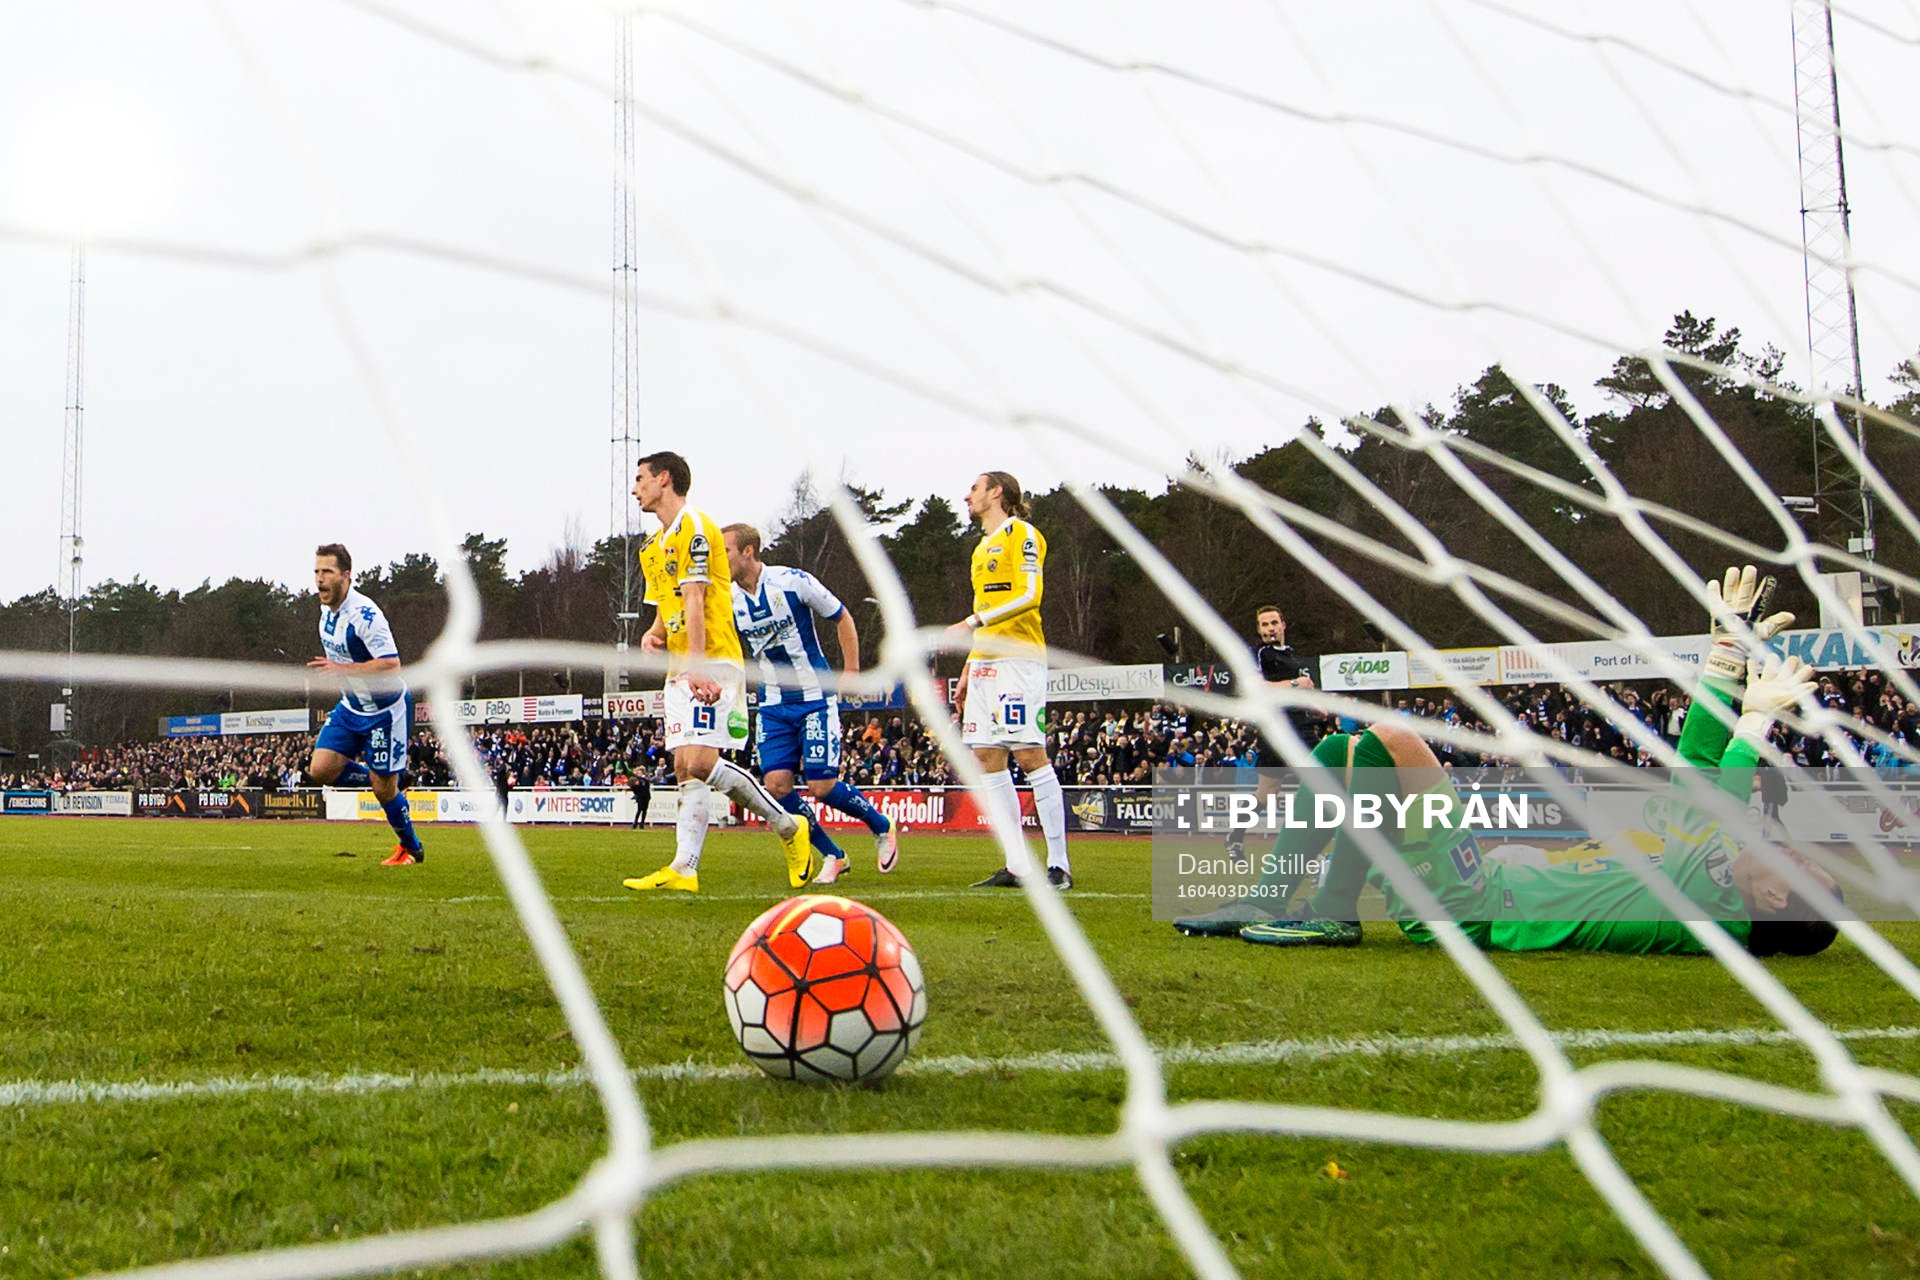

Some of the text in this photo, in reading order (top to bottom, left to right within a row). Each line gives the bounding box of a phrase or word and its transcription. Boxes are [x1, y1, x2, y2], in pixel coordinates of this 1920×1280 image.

[1594, 656, 1618, 667] Port
[1620, 655, 1631, 665] of
[486, 700, 511, 716] FaBo
[608, 699, 645, 713] BYGG
[374, 751, 388, 763] 10
[810, 745, 825, 758] 19
[547, 797, 615, 813] INTERSPORT
[1116, 803, 1175, 820] FALCON
